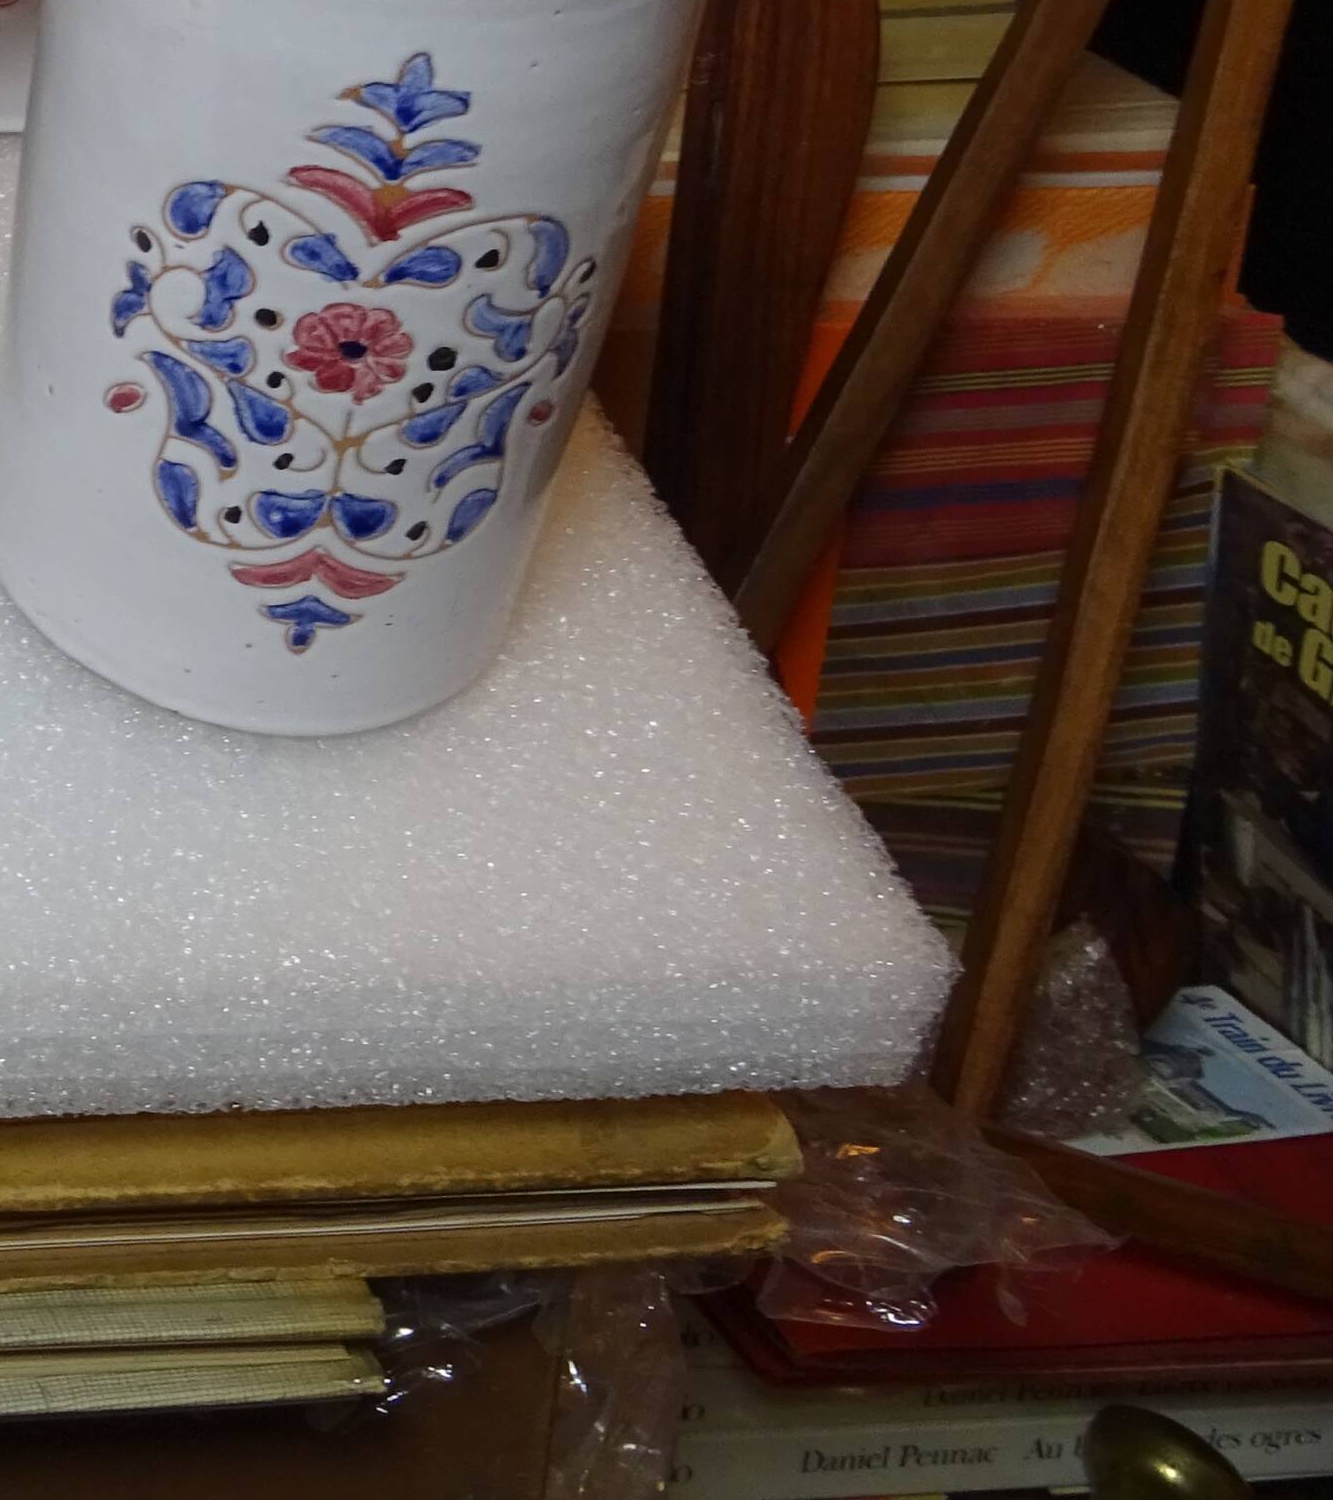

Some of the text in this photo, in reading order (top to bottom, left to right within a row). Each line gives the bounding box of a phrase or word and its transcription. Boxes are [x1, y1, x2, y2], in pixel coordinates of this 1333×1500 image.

[1261, 539, 1333, 635] Ca
[1203, 1012, 1270, 1054] Train
[1257, 1056, 1304, 1079] du
[800, 1445, 891, 1475] Daniel
[897, 1441, 999, 1468] Pennac
[1024, 1436, 1063, 1462] Au
[1249, 1427, 1322, 1456] ogres
